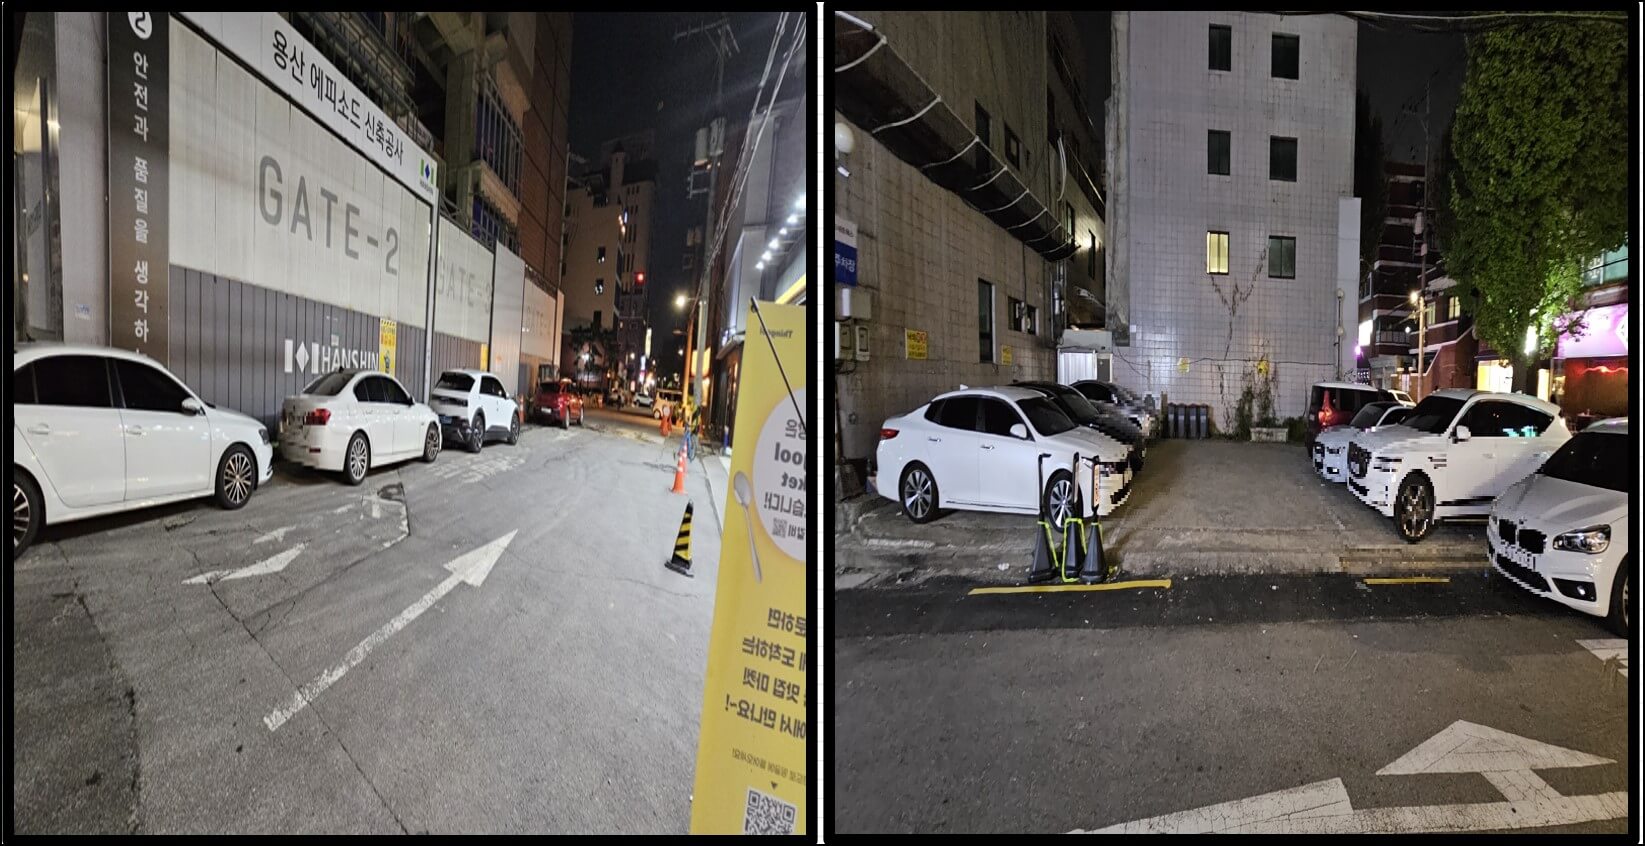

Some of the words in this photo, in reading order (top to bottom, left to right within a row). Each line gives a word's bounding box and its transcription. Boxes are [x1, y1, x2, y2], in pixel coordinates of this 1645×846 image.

[133, 51, 149, 142] 안전과
[272, 30, 305, 86] 용산
[310, 67, 362, 128] 에피소드
[365, 106, 404, 165] 신축공사
[133, 156, 149, 244] 품질을
[258, 155, 399, 277] GATE-2
[133, 260, 149, 357] 생각하
[321, 345, 379, 374] HANSHIN
